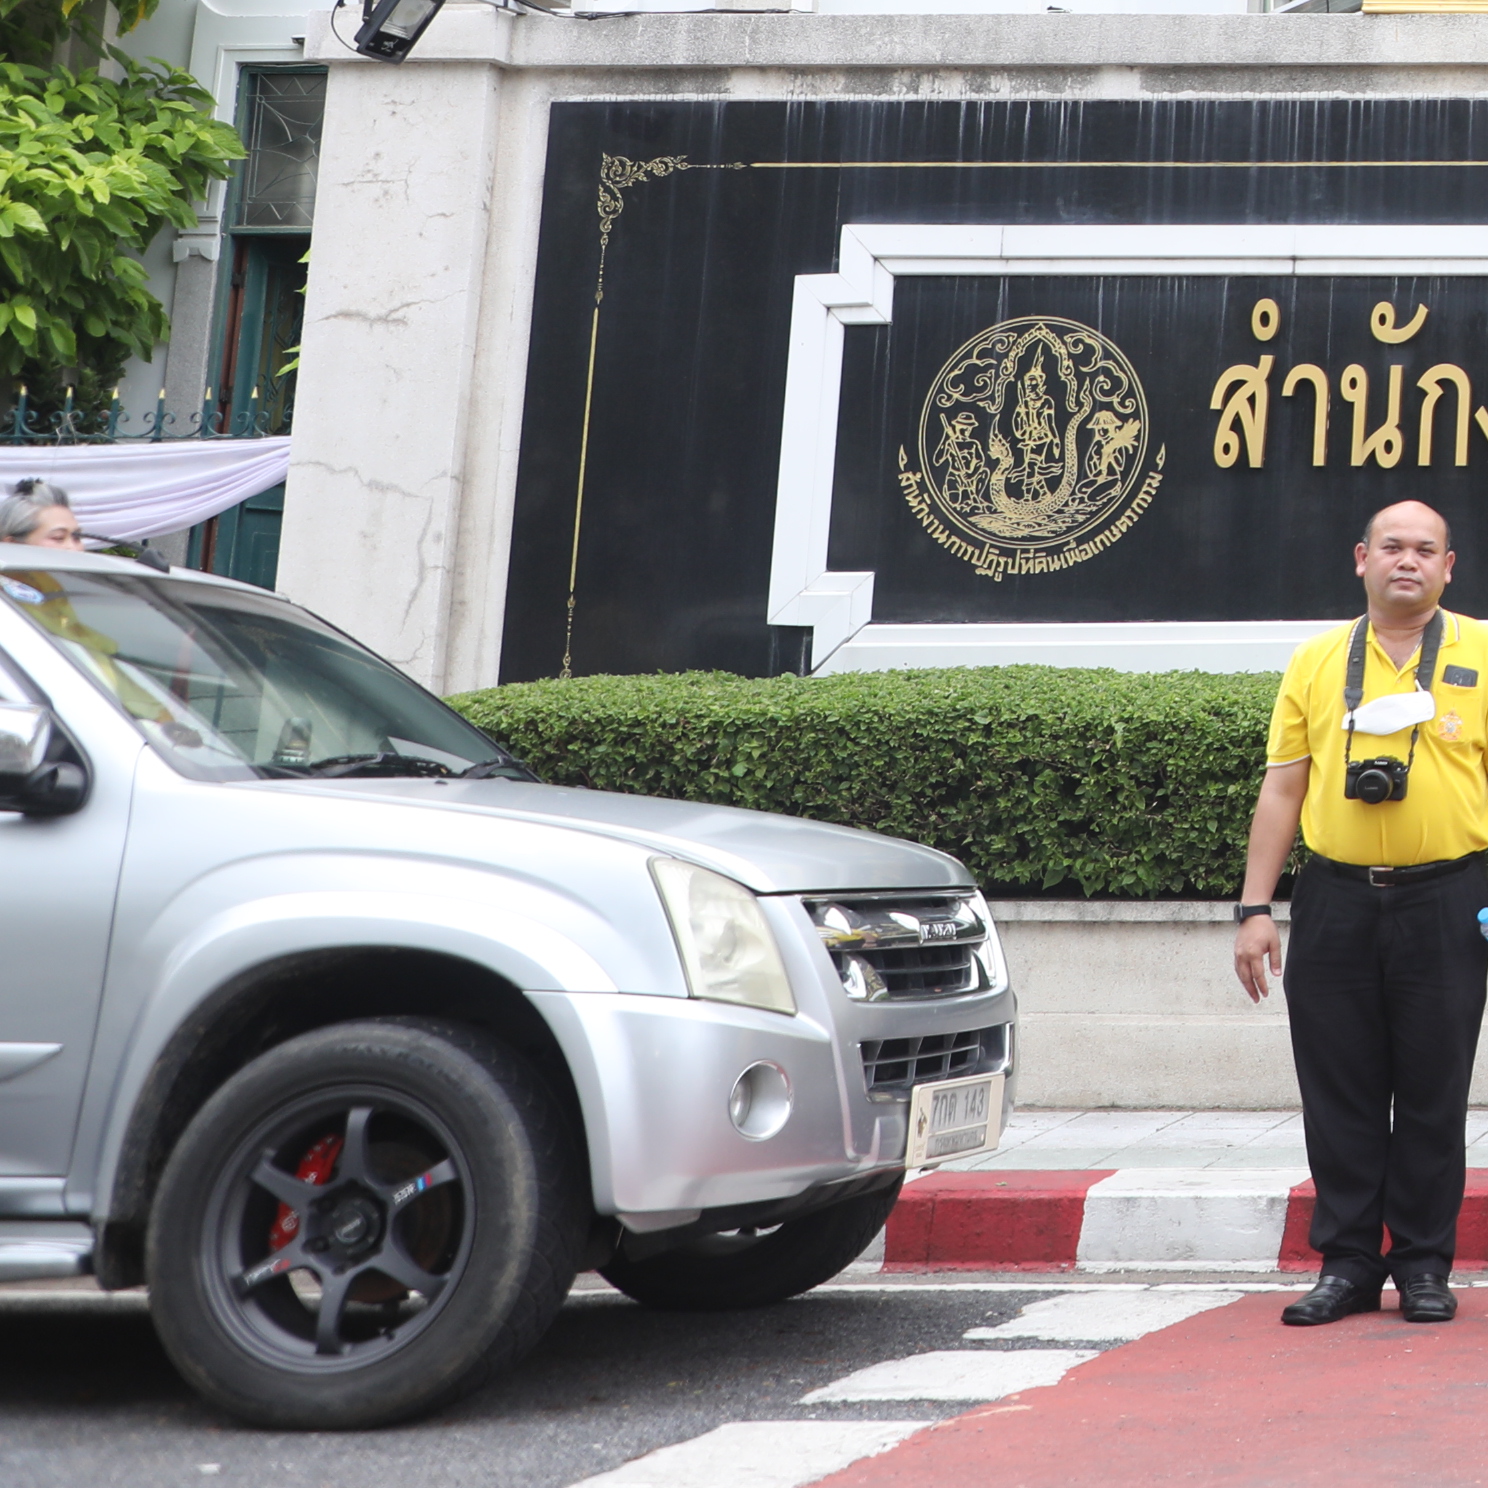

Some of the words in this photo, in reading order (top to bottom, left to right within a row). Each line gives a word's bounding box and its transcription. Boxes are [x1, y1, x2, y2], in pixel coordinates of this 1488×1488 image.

[898, 470, 1164, 582] สำนักงานการปฏิรูปที่ดินเพื่อเกษตรกรรม
[964, 1087, 985, 1120] 143
